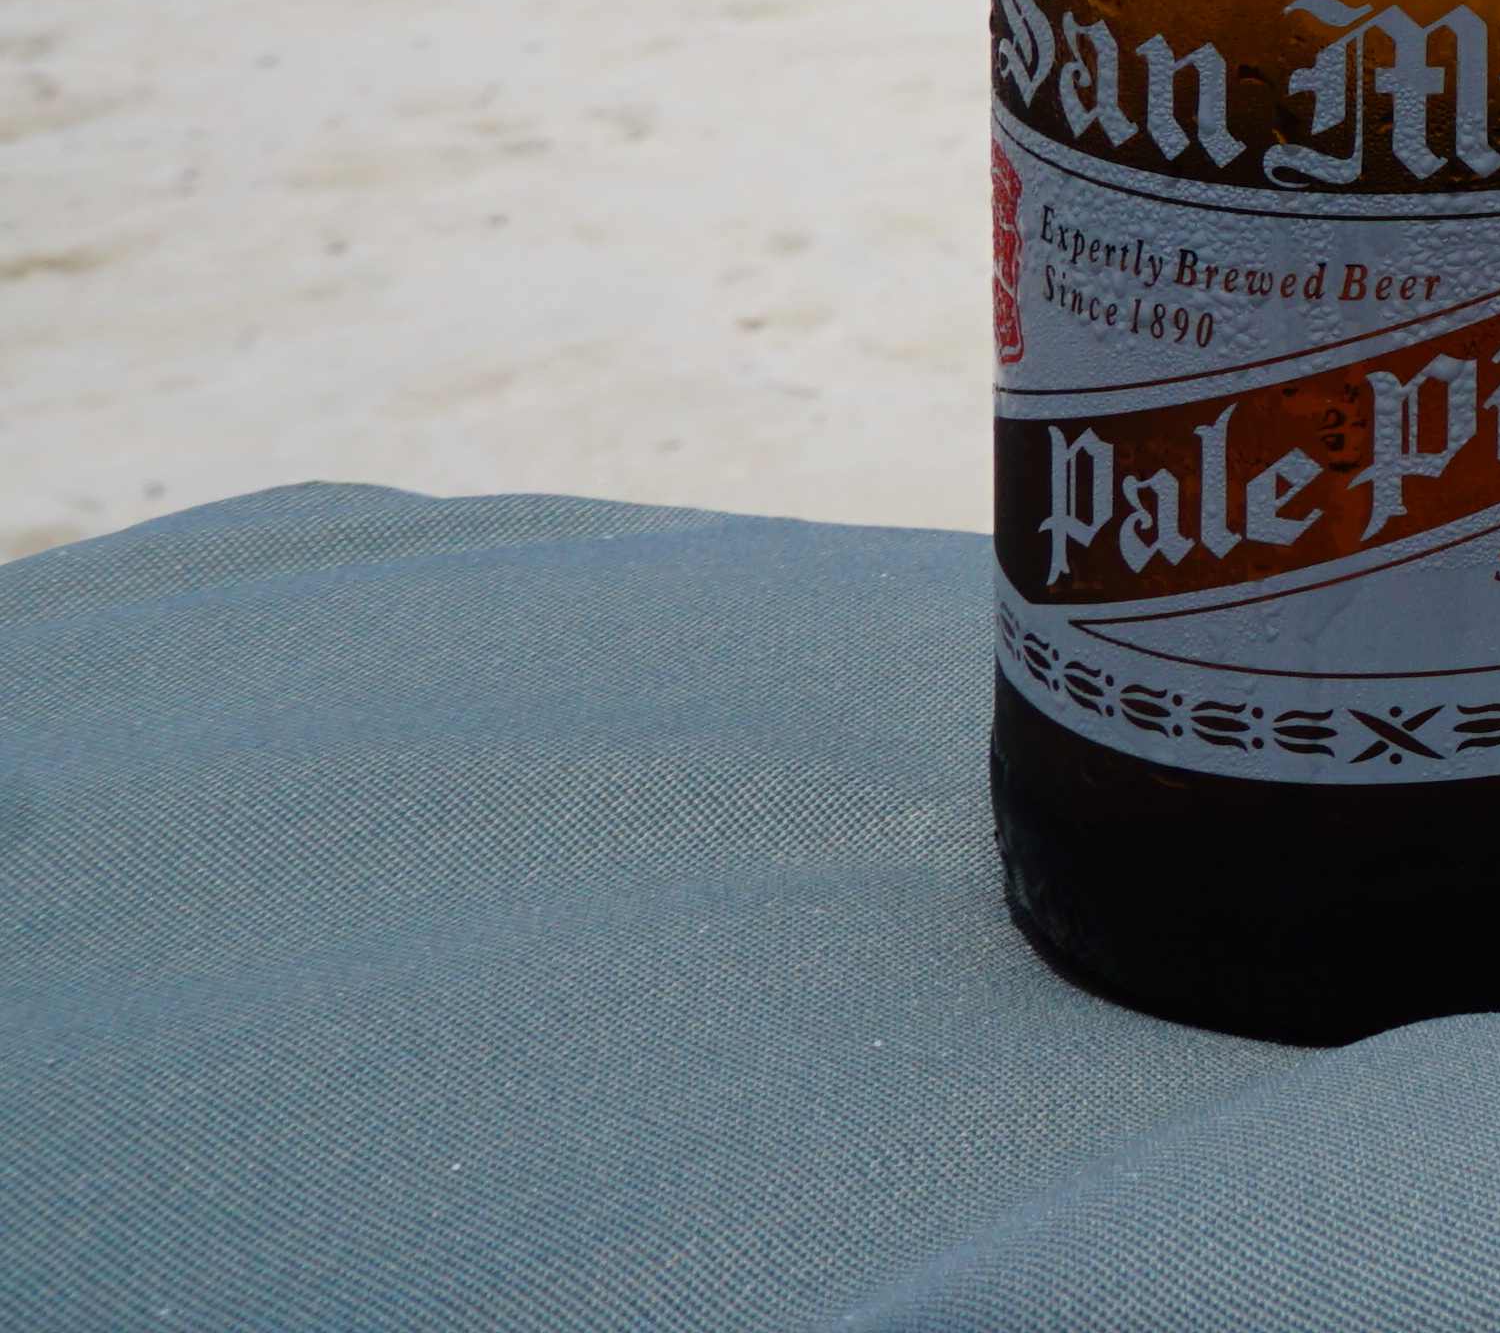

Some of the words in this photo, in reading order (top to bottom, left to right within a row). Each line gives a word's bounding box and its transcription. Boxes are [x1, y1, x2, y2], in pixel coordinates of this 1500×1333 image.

[1040, 204, 1165, 288] Expertly
[1173, 248, 1328, 300] Brewed
[1337, 263, 1443, 302] Beer
[1043, 264, 1119, 327] Since
[1129, 297, 1215, 349] 1890
[1038, 403, 1332, 586] Pale
